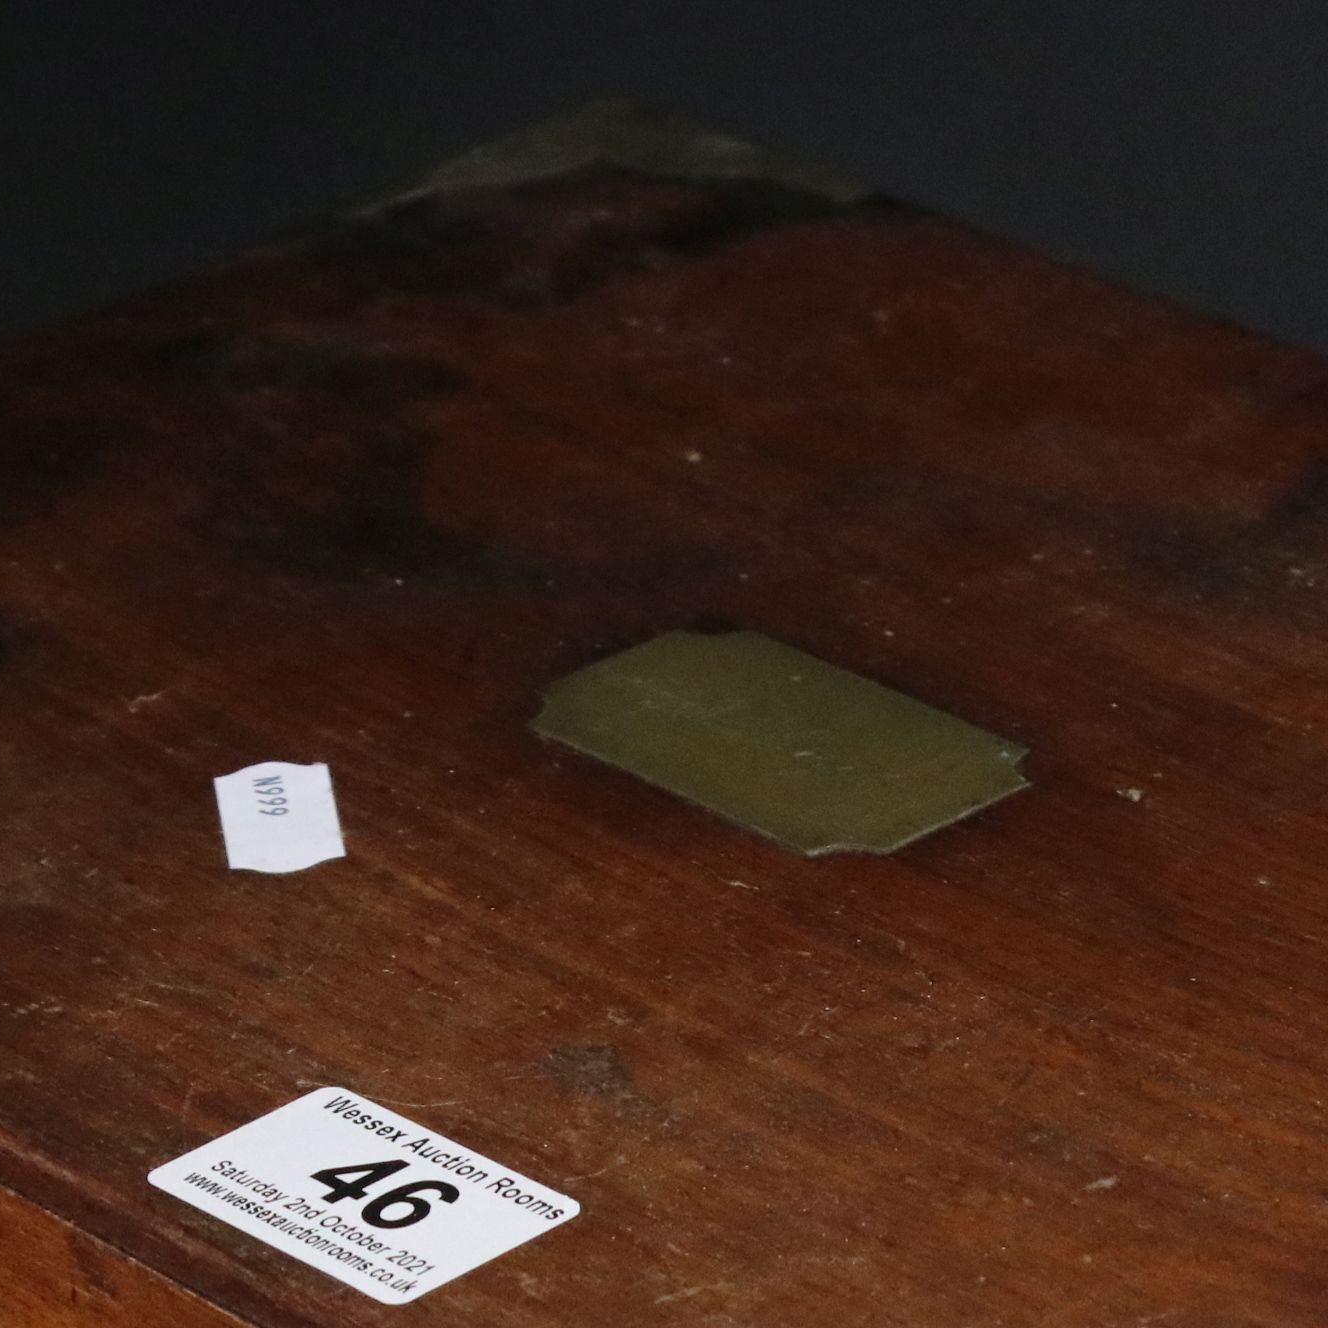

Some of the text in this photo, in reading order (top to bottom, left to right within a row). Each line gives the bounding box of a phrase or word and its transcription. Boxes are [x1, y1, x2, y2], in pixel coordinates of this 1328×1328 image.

[210, 1159, 434, 1276] Saturday 2nd October 2021
[309, 1160, 460, 1230] 46
[323, 1095, 565, 1221] Wessex Auction Rooms
[183, 1172, 415, 1294] www.wessexauctionrooms.co.uk
